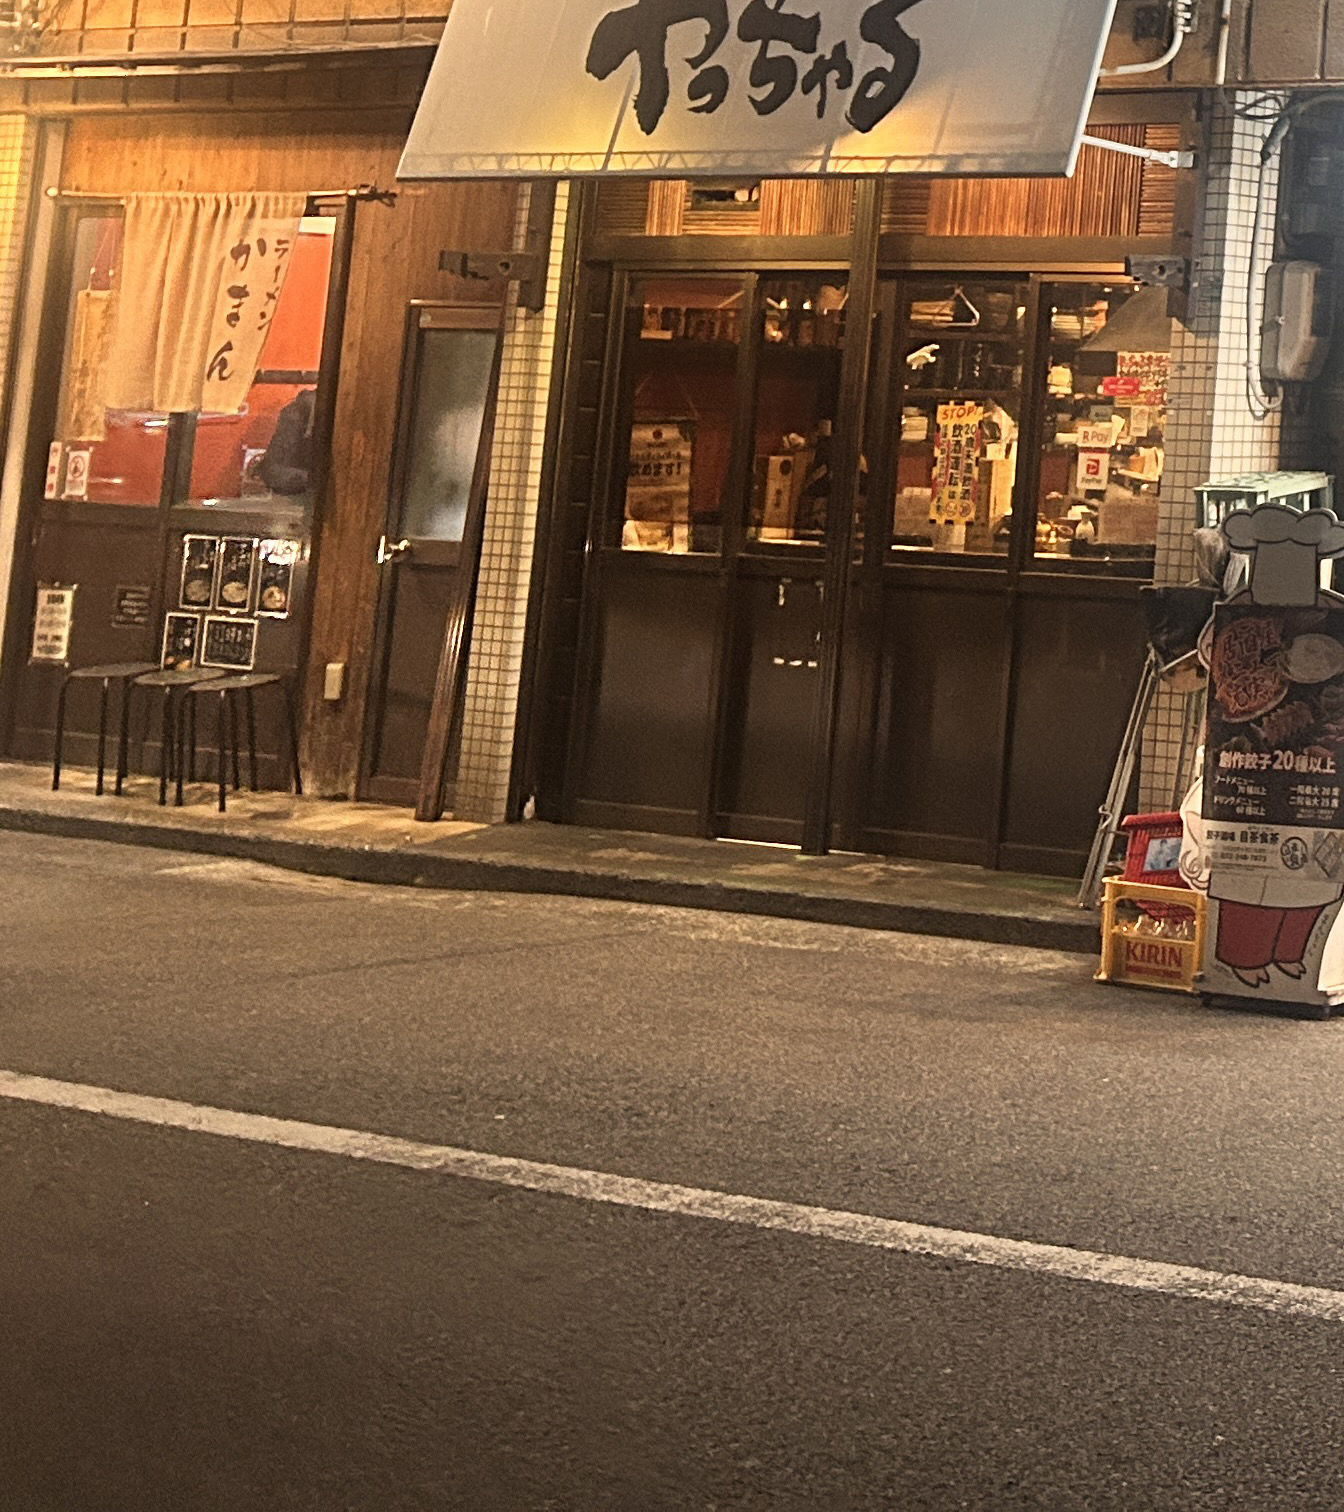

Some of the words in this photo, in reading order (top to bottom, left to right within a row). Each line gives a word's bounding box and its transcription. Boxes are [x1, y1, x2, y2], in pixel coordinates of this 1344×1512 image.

[206, 236, 268, 383] かまん
[256, 238, 291, 332] ラーメン
[1124, 940, 1184, 968] KIRIN
